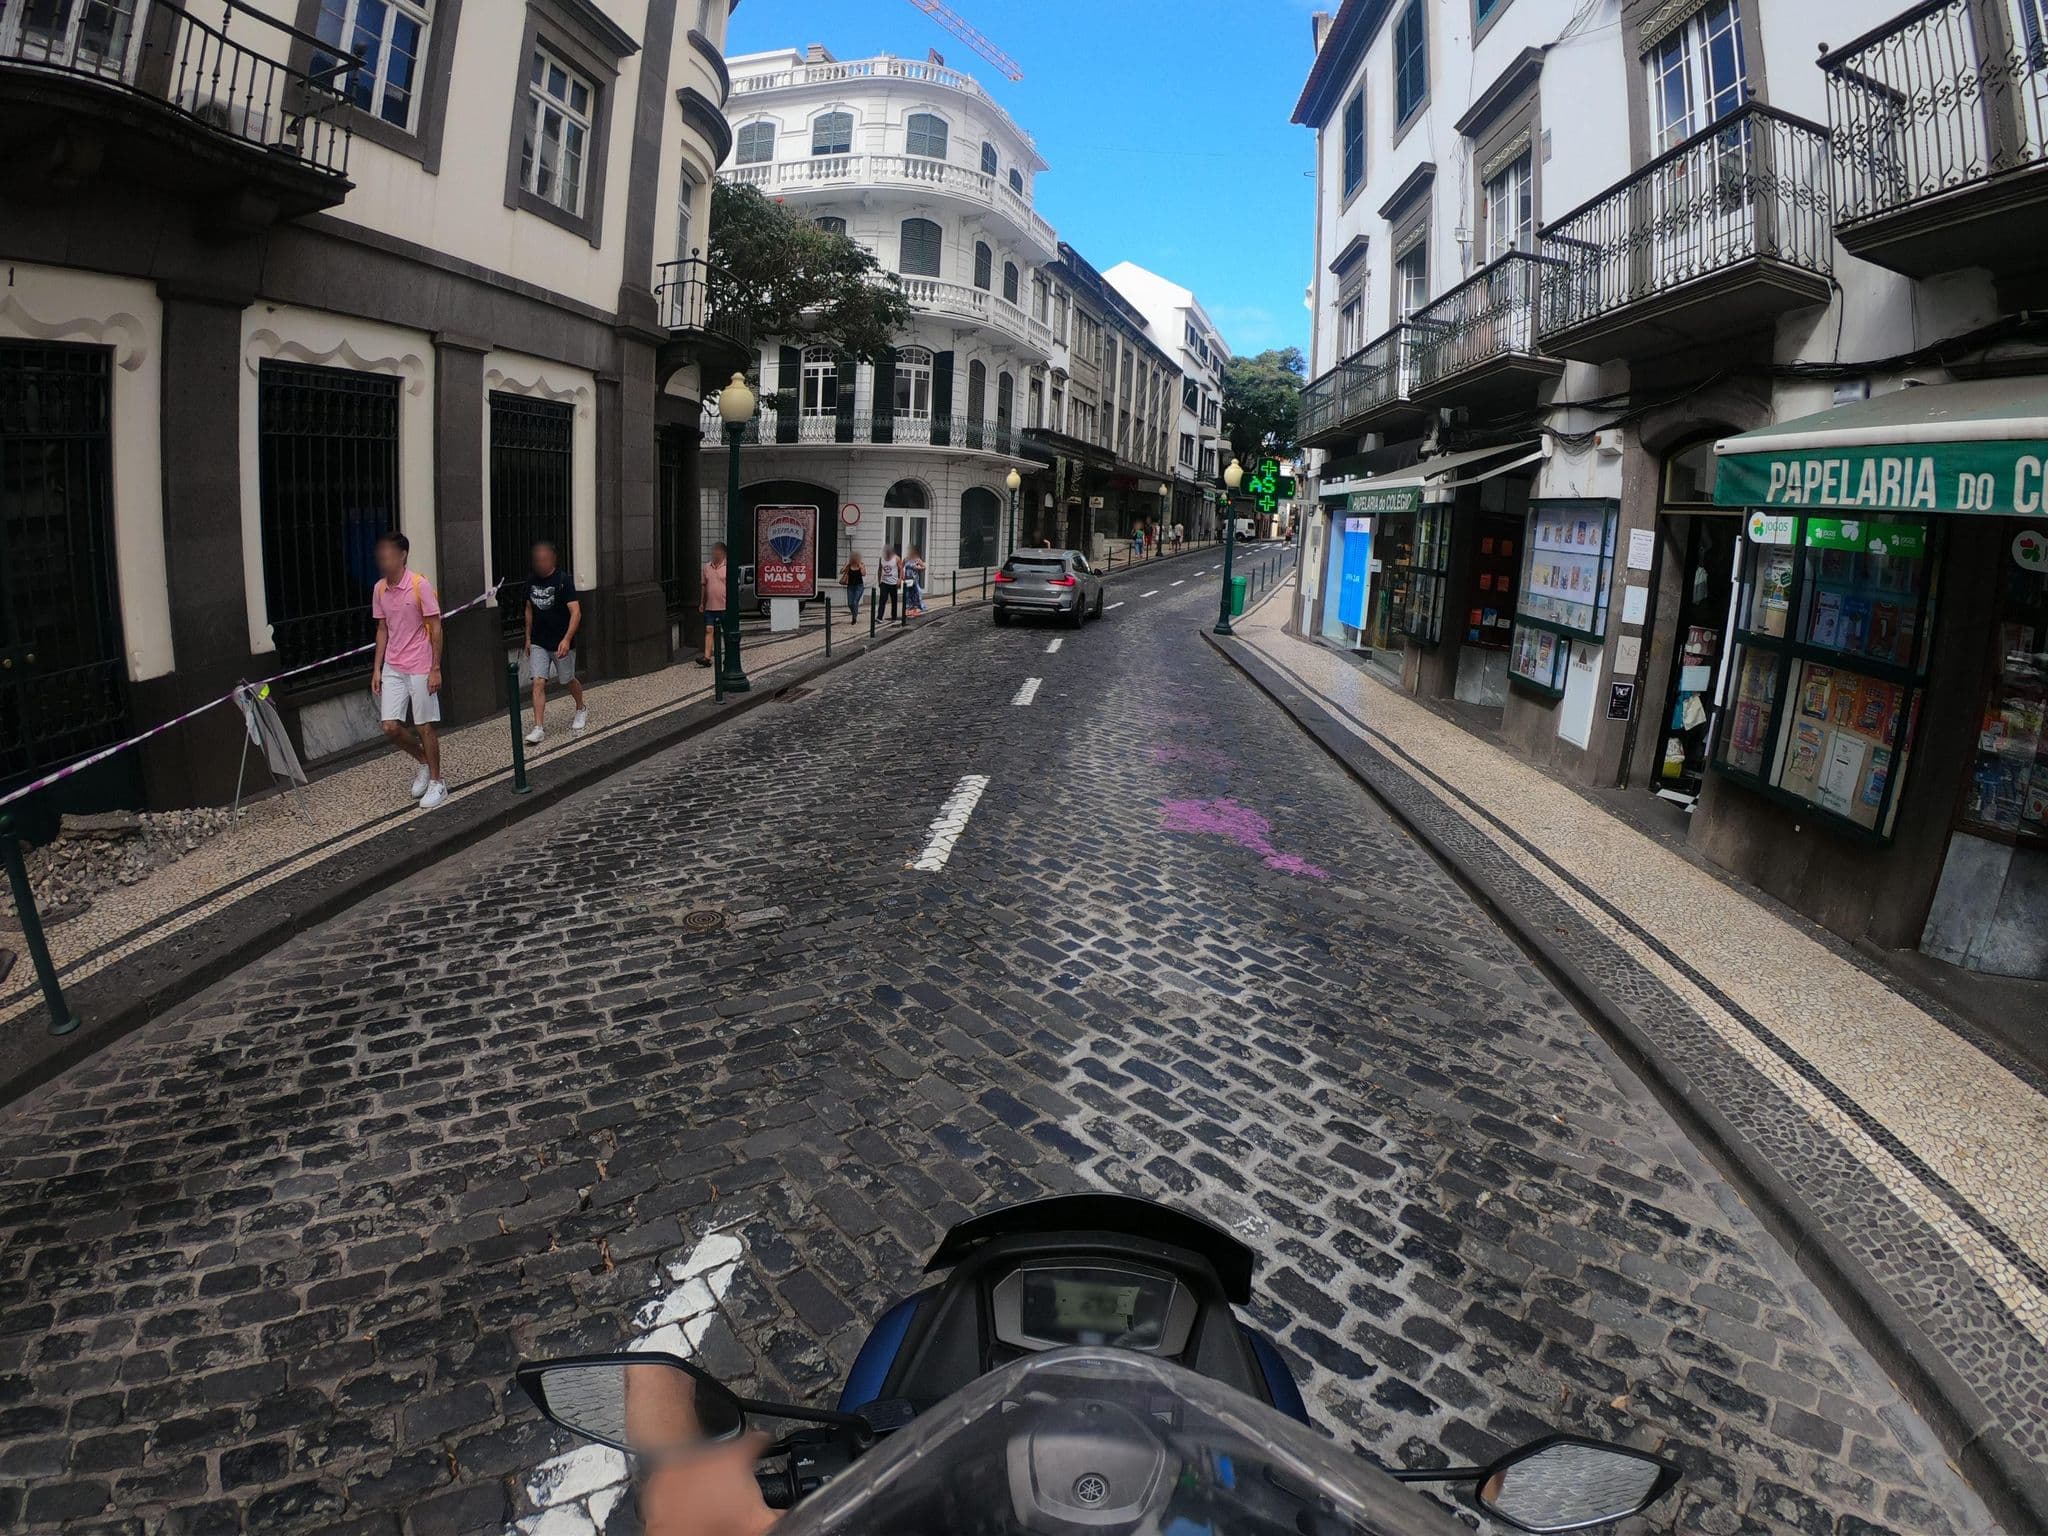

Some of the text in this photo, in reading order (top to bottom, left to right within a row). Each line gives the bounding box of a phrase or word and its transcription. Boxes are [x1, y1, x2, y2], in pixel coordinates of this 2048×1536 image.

[1766, 455, 2048, 514] PAPELARIA DO C
[1352, 495, 1378, 511] PAPELARIA
[1386, 490, 1411, 510] COLÉGIO
[1765, 521, 1788, 534] JOGOS
[764, 565, 806, 573] CADA VEZ
[764, 573, 794, 583] MAIS
